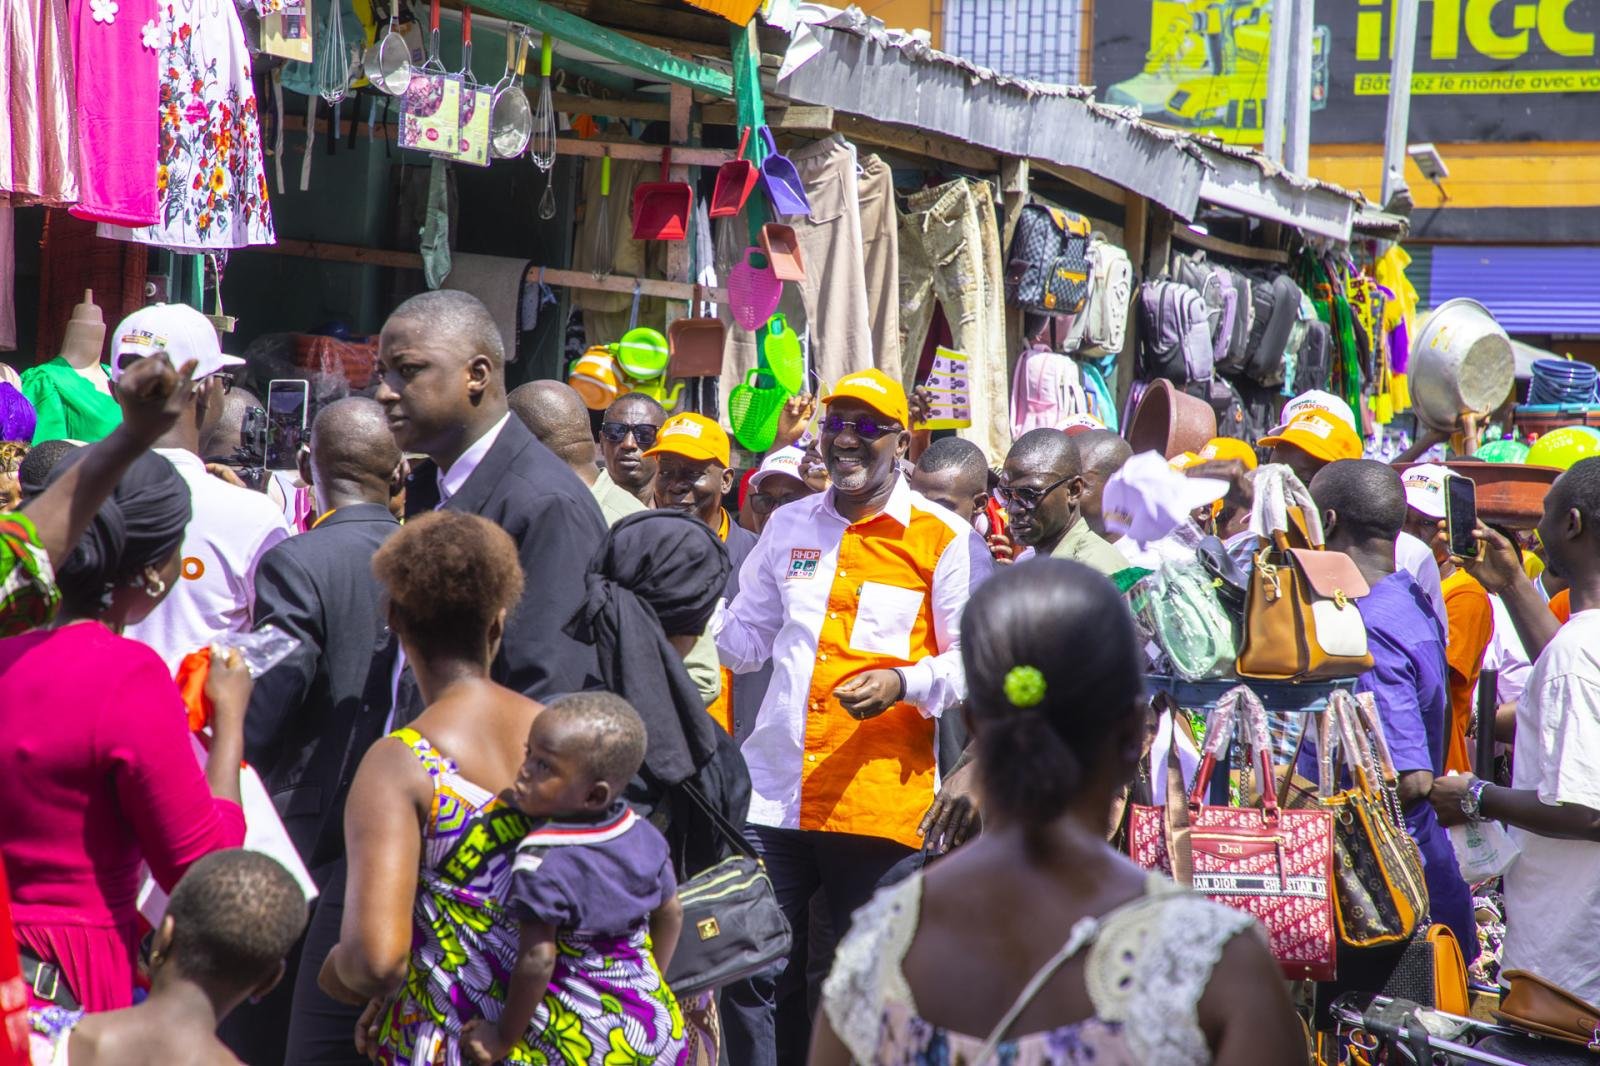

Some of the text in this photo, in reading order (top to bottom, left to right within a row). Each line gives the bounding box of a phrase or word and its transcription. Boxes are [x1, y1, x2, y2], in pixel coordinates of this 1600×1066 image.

[1439, 75, 1455, 90] le
[1459, 74, 1525, 91] monde
[1530, 76, 1575, 90] avec
[1213, 878, 1238, 890] DIOR
